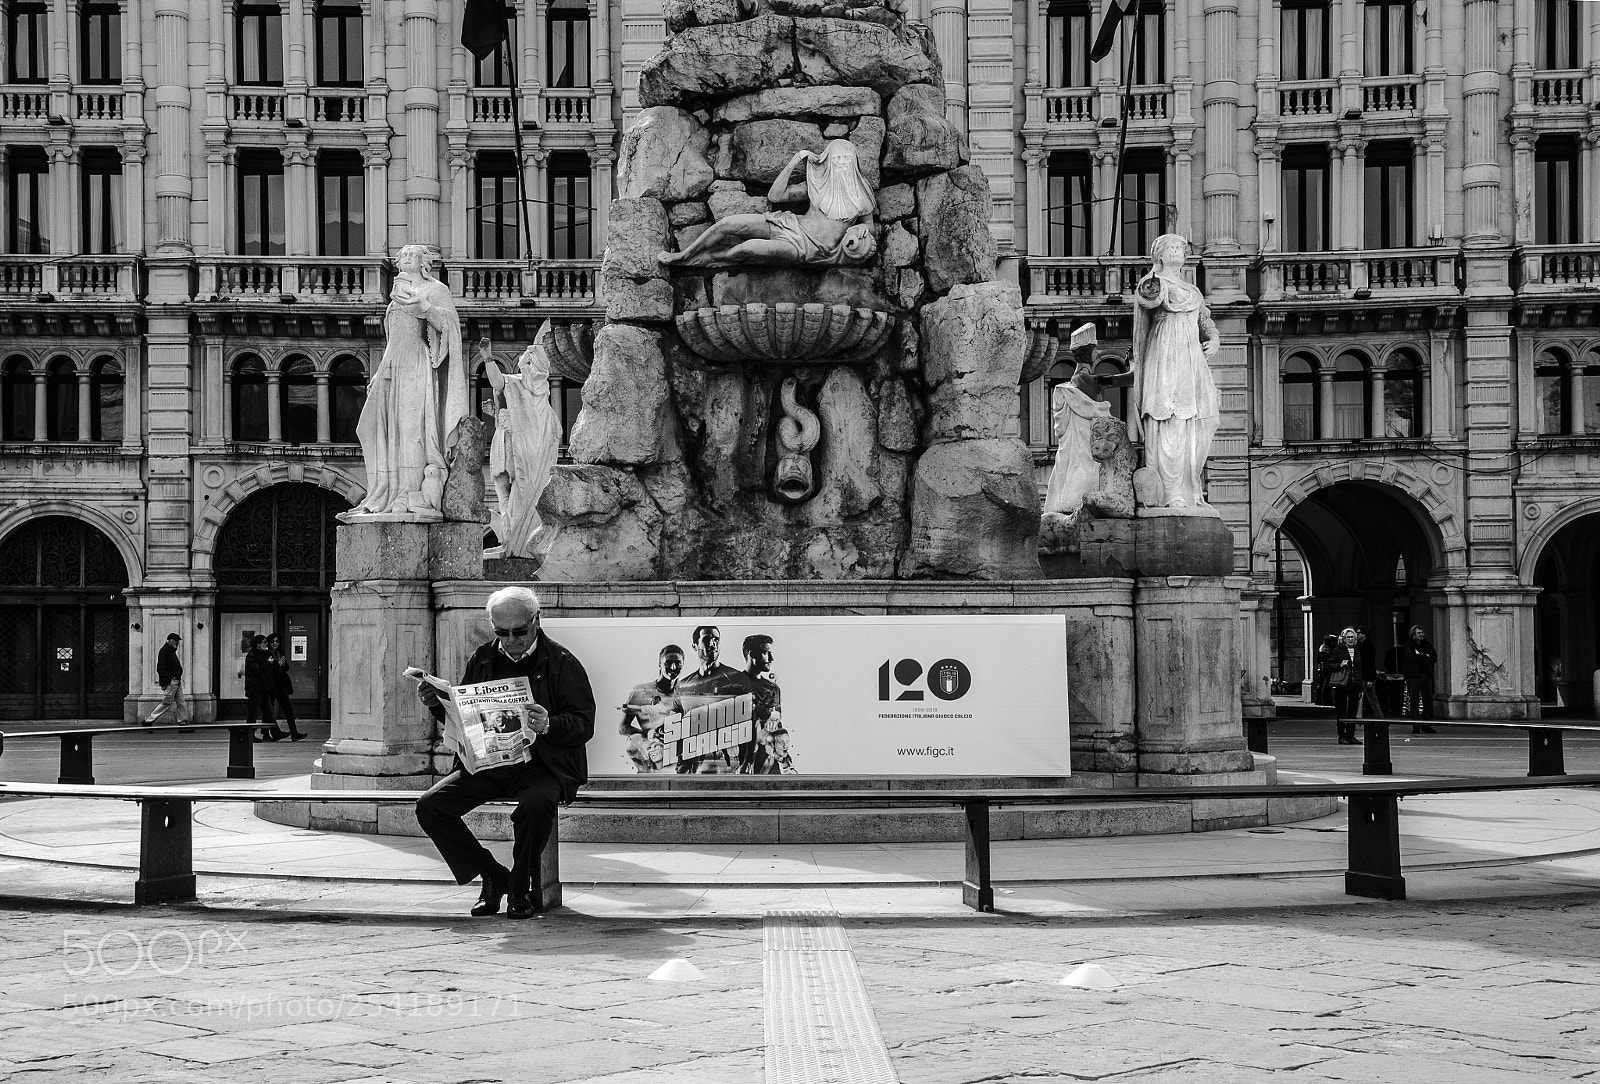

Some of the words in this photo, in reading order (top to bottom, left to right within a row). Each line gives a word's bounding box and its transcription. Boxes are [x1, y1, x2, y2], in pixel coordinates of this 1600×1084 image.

[878, 658, 972, 701] 120
[473, 685, 509, 695] Libero
[897, 746, 954, 758] www.figc.it
